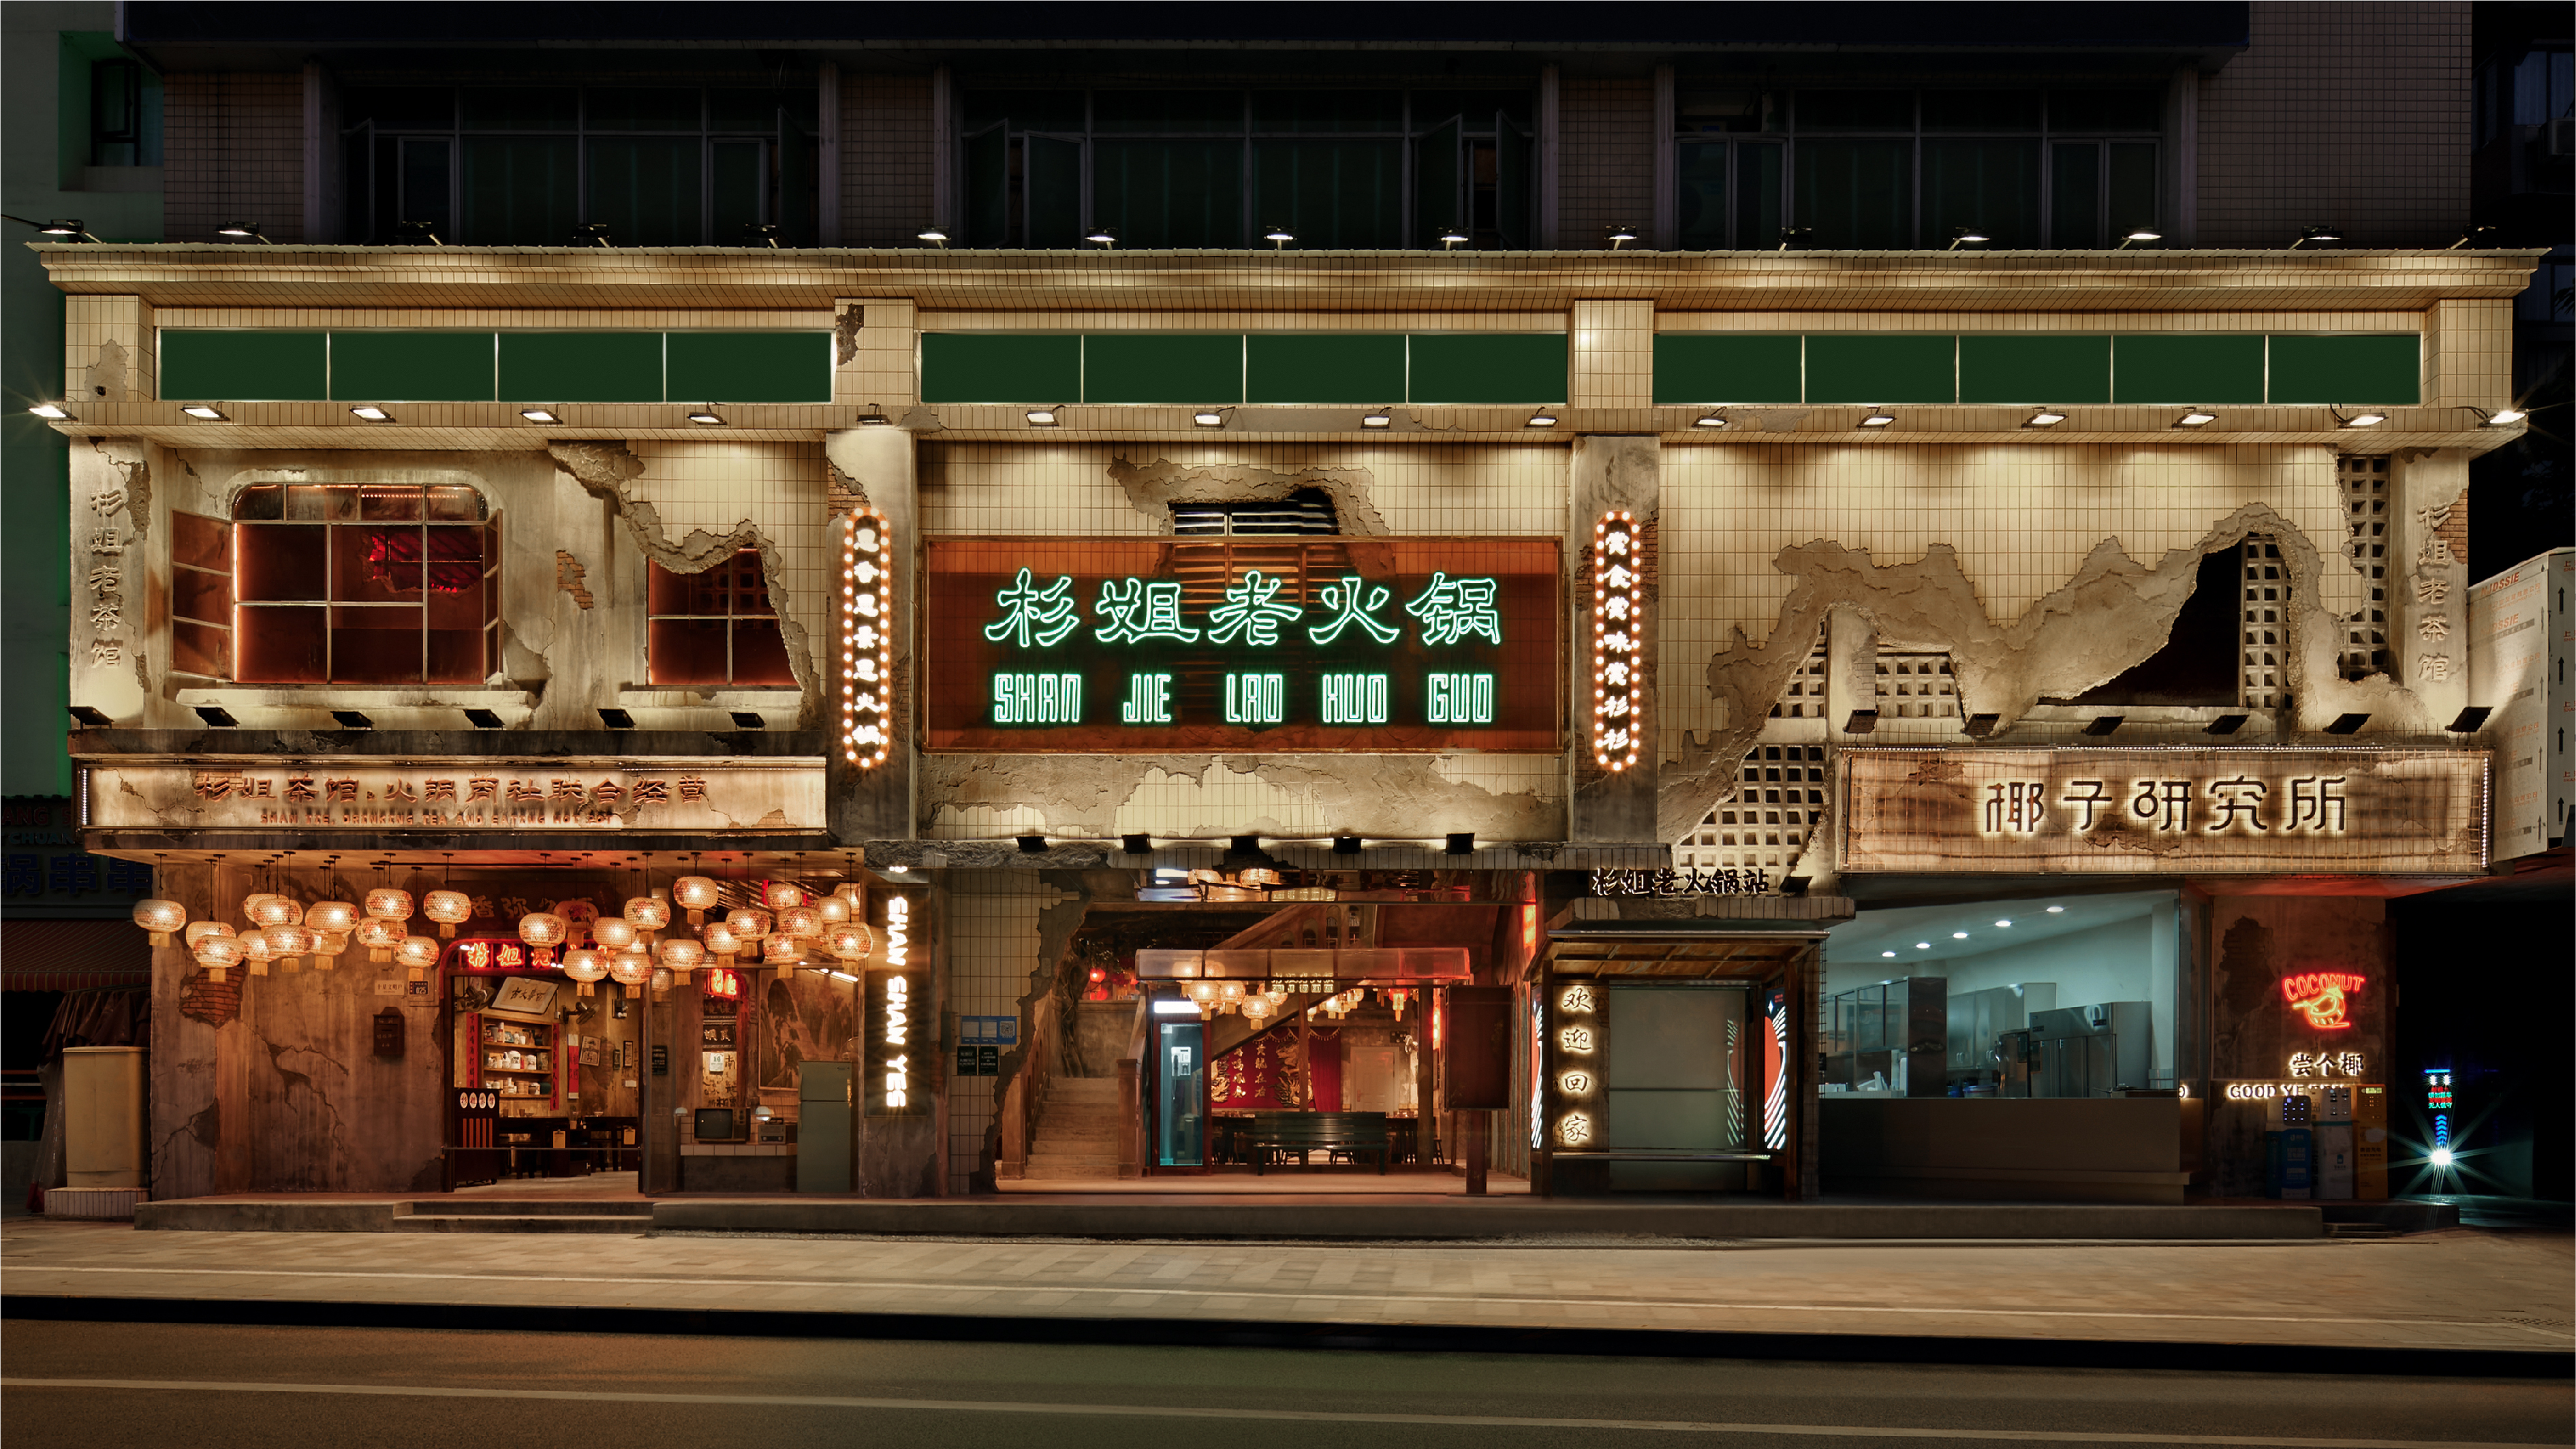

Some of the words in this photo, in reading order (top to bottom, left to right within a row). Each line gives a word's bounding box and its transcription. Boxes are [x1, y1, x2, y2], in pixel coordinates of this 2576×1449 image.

[90, 489, 124, 669] 杉姐老茶馆
[2417, 502, 2451, 681] 杉姐老茶馆
[985, 567, 1501, 647] 杉姐老火锅
[994, 673, 1081, 724] SHAN
[1123, 673, 1172, 724] JIE
[1226, 673, 1283, 724] LAO
[1323, 673, 1388, 724] HUO
[1428, 673, 1493, 724] GUO
[260, 813, 298, 825] SHAN
[343, 813, 413, 825] DRINKING
[422, 813, 447, 825] TEA
[456, 813, 483, 825] AND
[493, 813, 545, 825] EATING
[553, 813, 580, 825] HOT
[1986, 775, 2346, 833] 椰子研究所
[1592, 868, 1770, 896] 杉姐老火锅站
[886, 897, 909, 966] SHAN
[886, 976, 908, 1045] SHAN
[2282, 973, 2365, 1001] COCONUT
[886, 1054, 907, 1107] YES
[1564, 987, 1592, 1142] 欢迎回家
[2229, 1085, 2277, 1099] GOOD
[2290, 1053, 2365, 1077] 尝个椰
